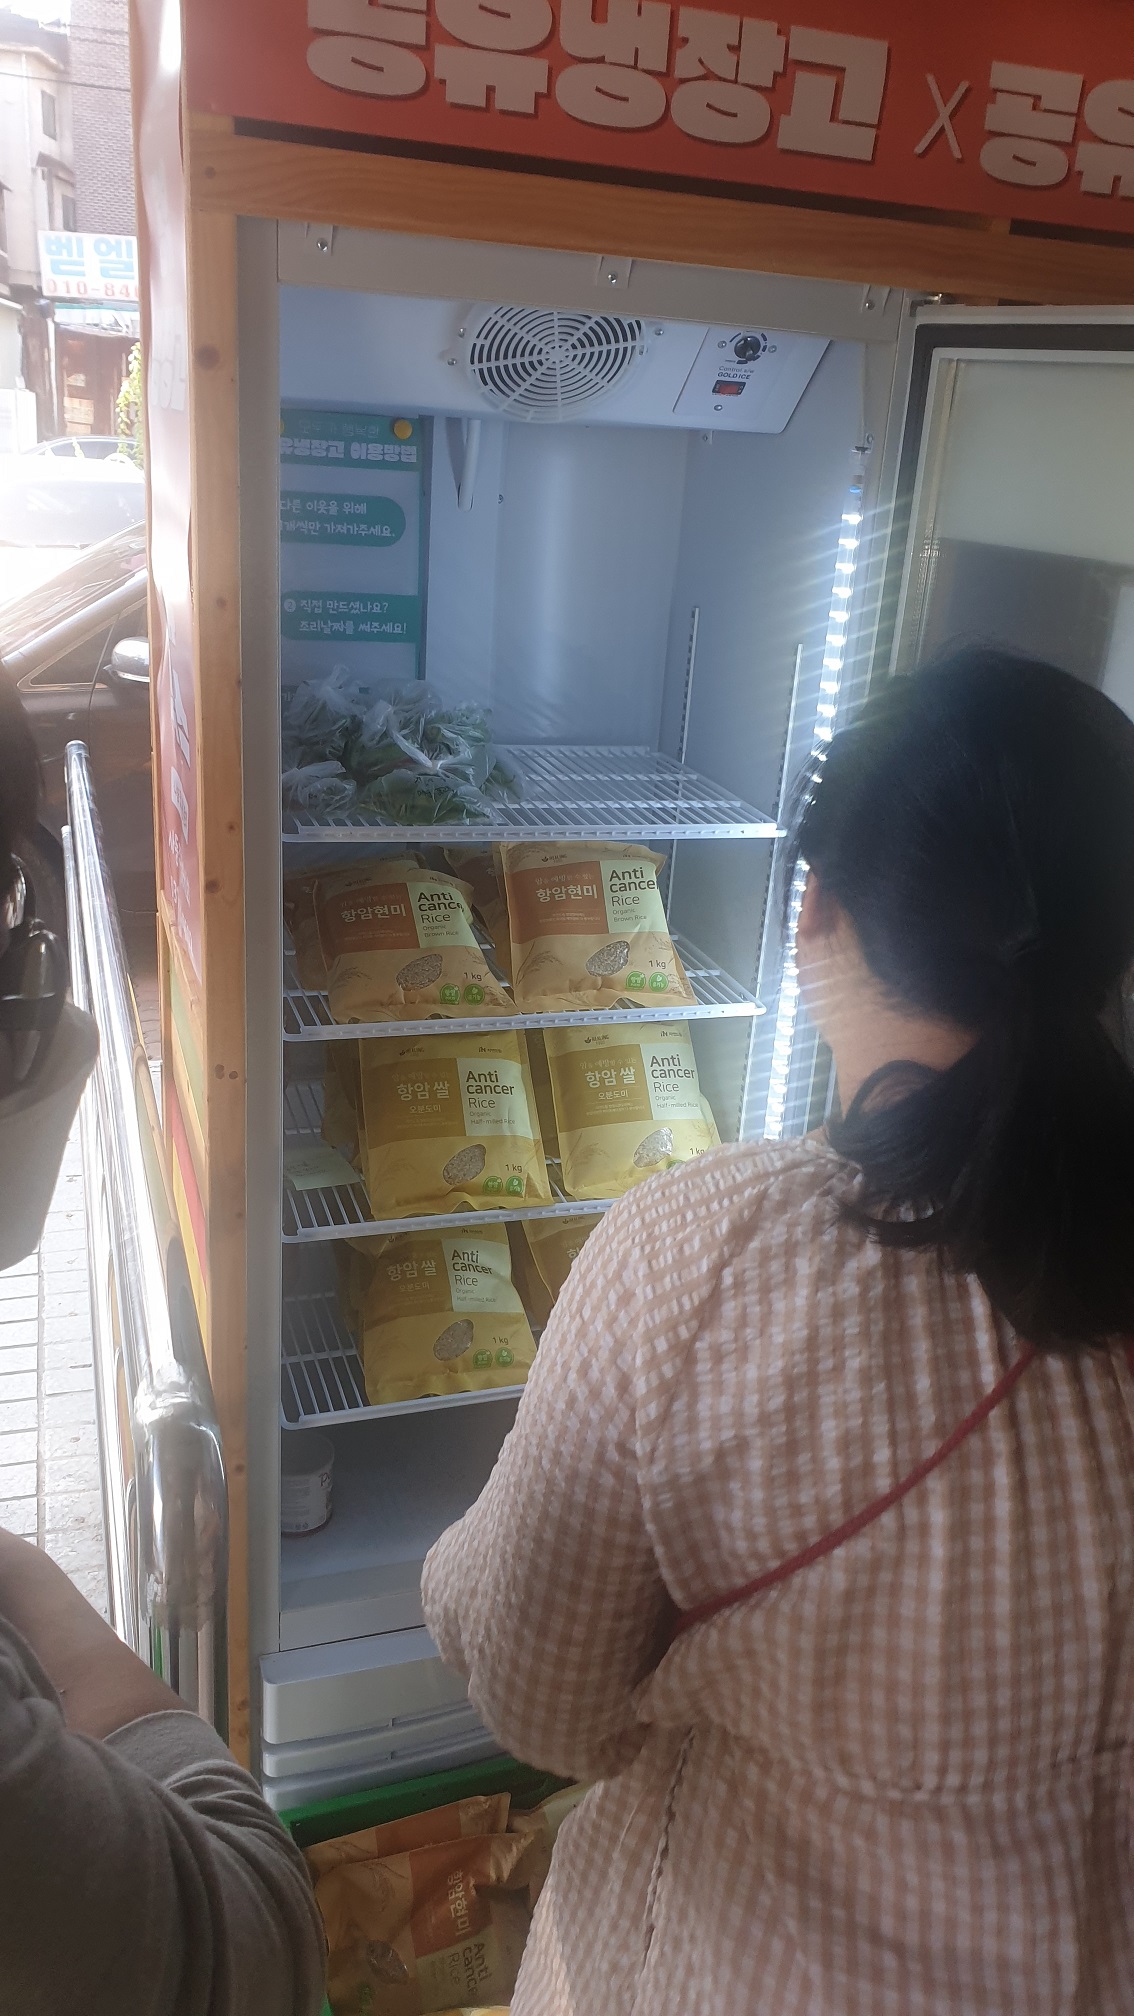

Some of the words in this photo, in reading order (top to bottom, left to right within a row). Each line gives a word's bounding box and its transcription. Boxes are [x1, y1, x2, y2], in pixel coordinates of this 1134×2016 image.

[300, 600, 322, 614] 직접
[609, 866, 645, 882] Anti
[418, 891, 453, 903] Anti
[536, 884, 598, 903] 항암현미
[611, 895, 640, 907] Rice
[341, 903, 406, 924] 항암현미
[421, 913, 451, 924] Rice
[648, 960, 653, 968] 1
[655, 959, 667, 970] kg
[471, 972, 483, 981] kg
[650, 1054, 681, 1068] Anti
[466, 1070, 499, 1083] Anti
[585, 1068, 617, 1088] 항암
[620, 1066, 636, 1084] 쌀
[651, 1067, 695, 1079] cancer
[396, 1082, 431, 1101] 항암
[433, 1081, 450, 1100] 쌀
[466, 1083, 514, 1096] cancer
[653, 1082, 680, 1093] Rice
[598, 1089, 629, 1100] 오분도미
[409, 1105, 441, 1114] 오분도미
[468, 1098, 496, 1109] Rice
[689, 1147, 694, 1155] 1
[511, 1164, 523, 1174] kg
[451, 1249, 479, 1264] Anti
[386, 1260, 419, 1282] 항암
[421, 1259, 437, 1276] 쌀
[452, 1261, 493, 1275] cancer
[454, 1275, 479, 1287] Rice
[499, 1336, 509, 1345] kg
[473, 1943, 492, 1982] Anti
